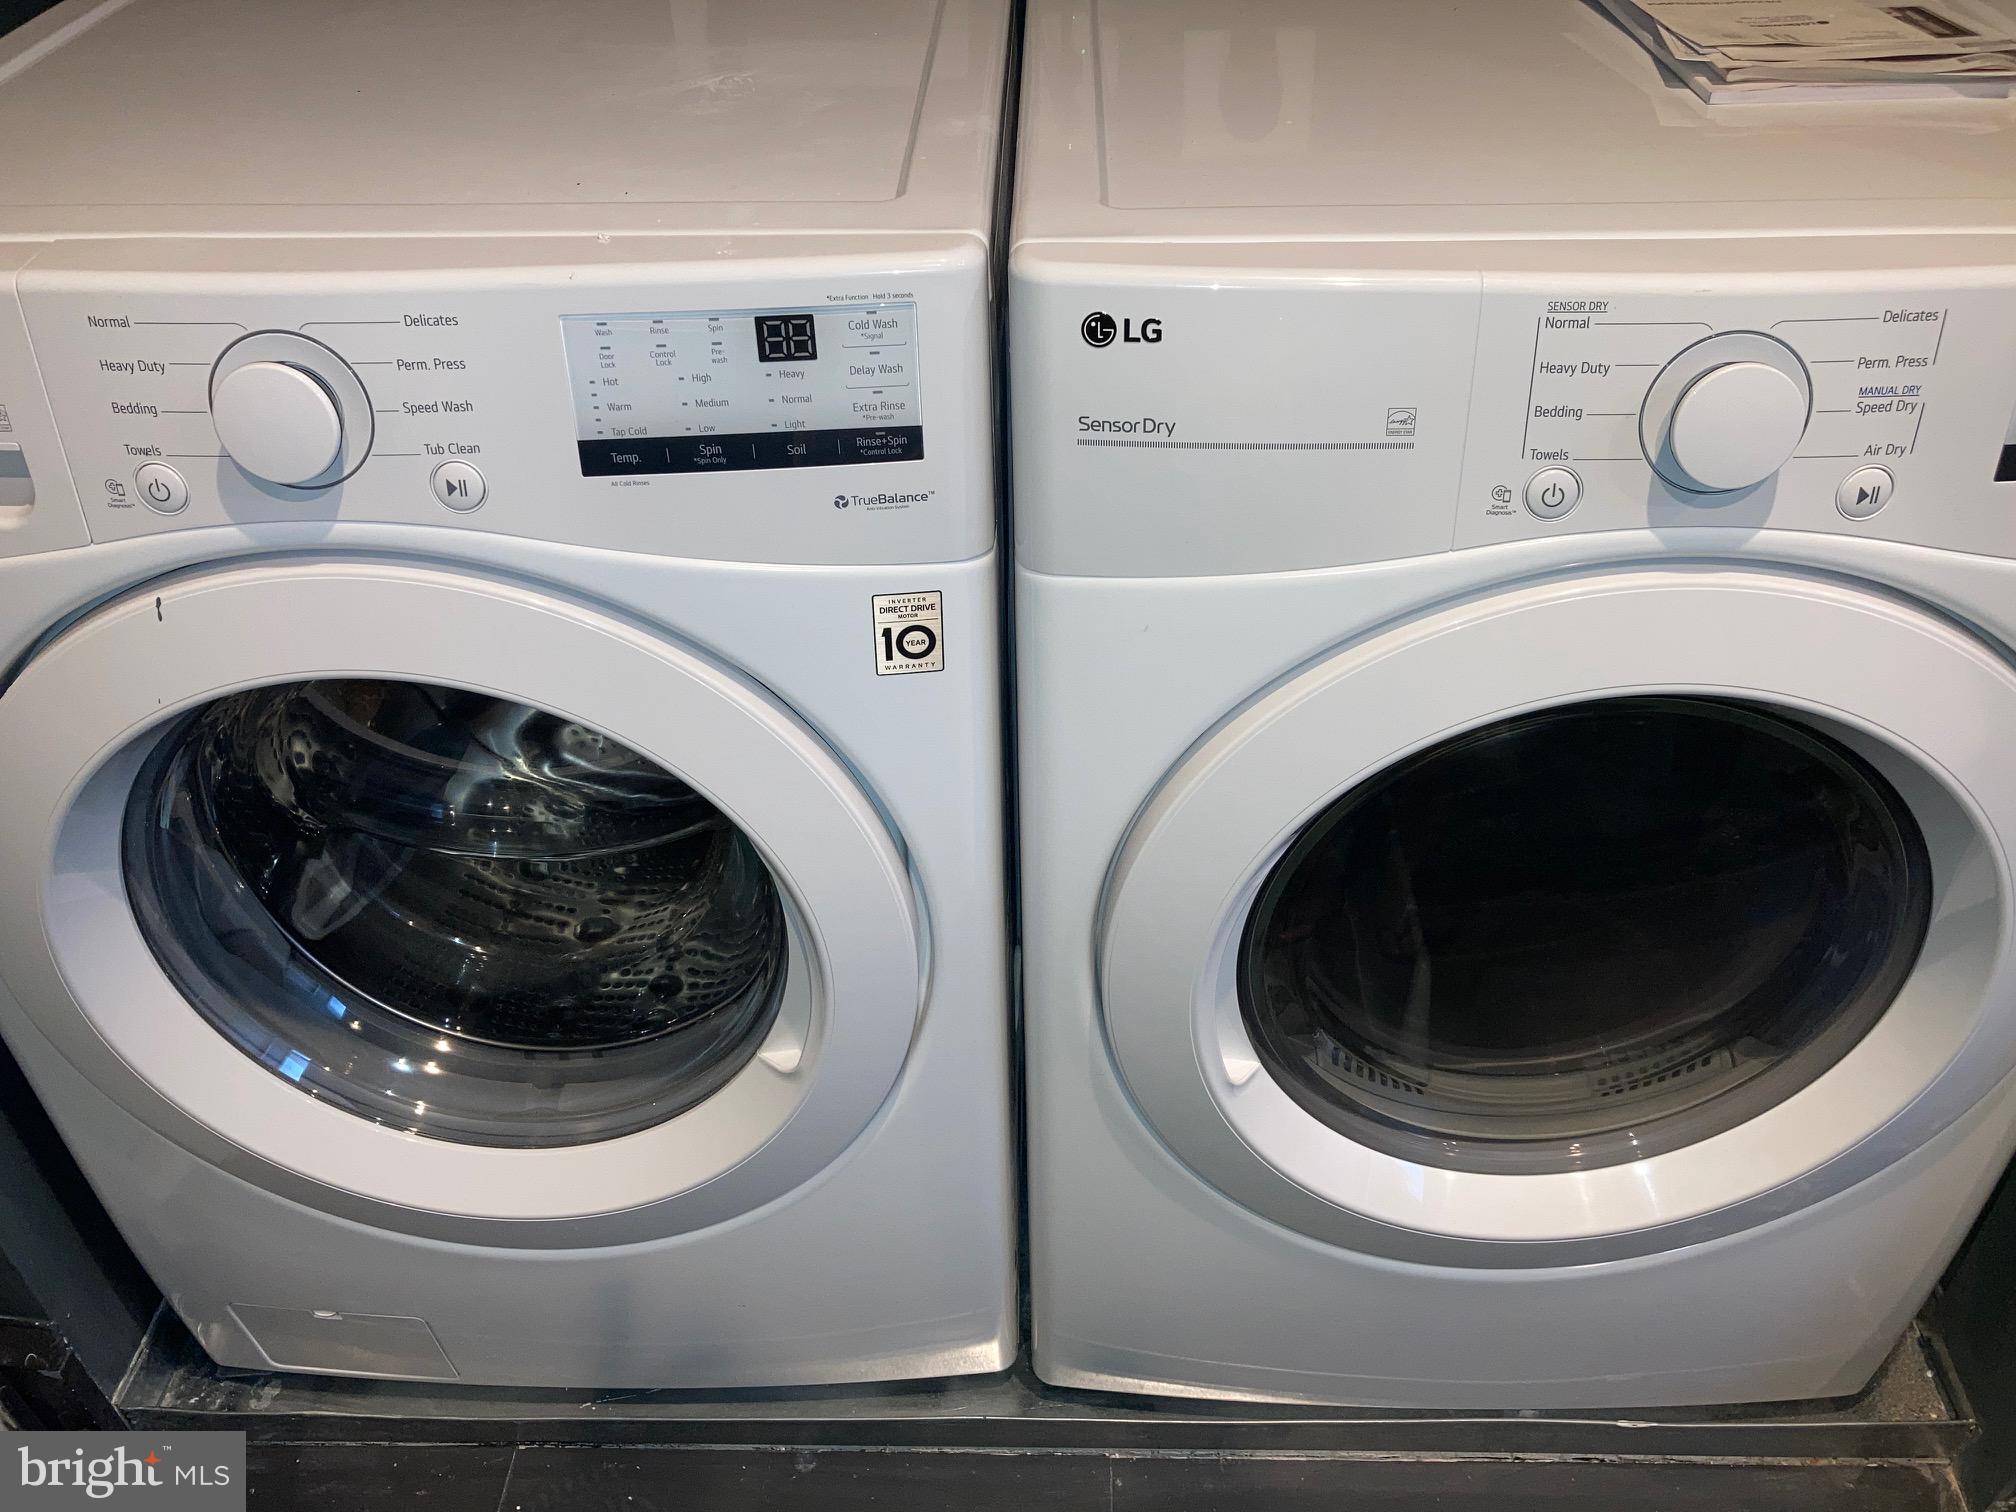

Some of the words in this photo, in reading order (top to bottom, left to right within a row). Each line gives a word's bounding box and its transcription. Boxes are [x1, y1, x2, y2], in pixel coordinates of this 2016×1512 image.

[1547, 301, 1586, 311] SENSOR
[1588, 301, 1609, 311] DRY
[87, 315, 131, 328] Normal
[403, 314, 459, 327] Delicates
[1882, 309, 1939, 323] Delicates
[848, 319, 870, 331] Cold
[872, 318, 898, 330] Wash
[1544, 316, 1591, 329] Normal
[594, 328, 613, 337] Wash
[649, 327, 669, 335] Rinse
[707, 324, 724, 334] Spin
[1123, 318, 1163, 343] LG
[649, 350, 676, 359] Control
[711, 356, 728, 364] wash
[99, 359, 135, 375] Heavy
[137, 359, 165, 375] Duty
[396, 359, 431, 371] Perm.
[433, 358, 466, 370] Press
[600, 361, 616, 369] Lock
[655, 358, 672, 367] Lock
[1857, 357, 1891, 369] Perm.
[1895, 355, 1928, 368] Press
[779, 369, 805, 380] Heavy
[849, 365, 876, 377] Delay
[878, 363, 904, 375] Wash
[1539, 361, 1578, 377] Heavy
[1581, 361, 1611, 377] Duty
[602, 378, 619, 387] Hot
[691, 373, 712, 384] High
[1858, 386, 1899, 396] MANUAL
[1901, 385, 1922, 396] DRY
[695, 399, 730, 408] Medium
[781, 394, 812, 404] Normal
[111, 402, 158, 417] Bedding
[402, 401, 439, 416] Speed
[441, 400, 474, 413] Wash
[607, 403, 632, 412] Warm
[853, 402, 878, 413] Extra
[880, 400, 906, 411] Rinse
[1855, 400, 1893, 416] Speed
[1896, 399, 1918, 415] Dry
[1534, 405, 1583, 421] Bedding
[698, 424, 716, 433] Low
[784, 420, 806, 430] Light
[611, 428, 627, 437] Tap
[628, 426, 648, 436] Cold
[856, 435, 908, 448] Rinse+Spin
[123, 444, 162, 457] Towels
[424, 443, 445, 455] Tub
[448, 442, 481, 454] Clean
[699, 444, 723, 457] Spin
[786, 445, 807, 456] Soil
[887, 447, 903, 455] Lock
[1530, 448, 1569, 461] Towels
[1864, 443, 1883, 456] Air
[1885, 443, 1907, 458] Dry
[610, 452, 643, 465] Temp.
[712, 456, 727, 465] Only
[879, 605, 909, 614] DIRECT
[910, 603, 936, 612] DRIVE
[881, 624, 937, 662] 10
[905, 639, 927, 647] YEAR
[884, 661, 936, 671] WARRANTY
